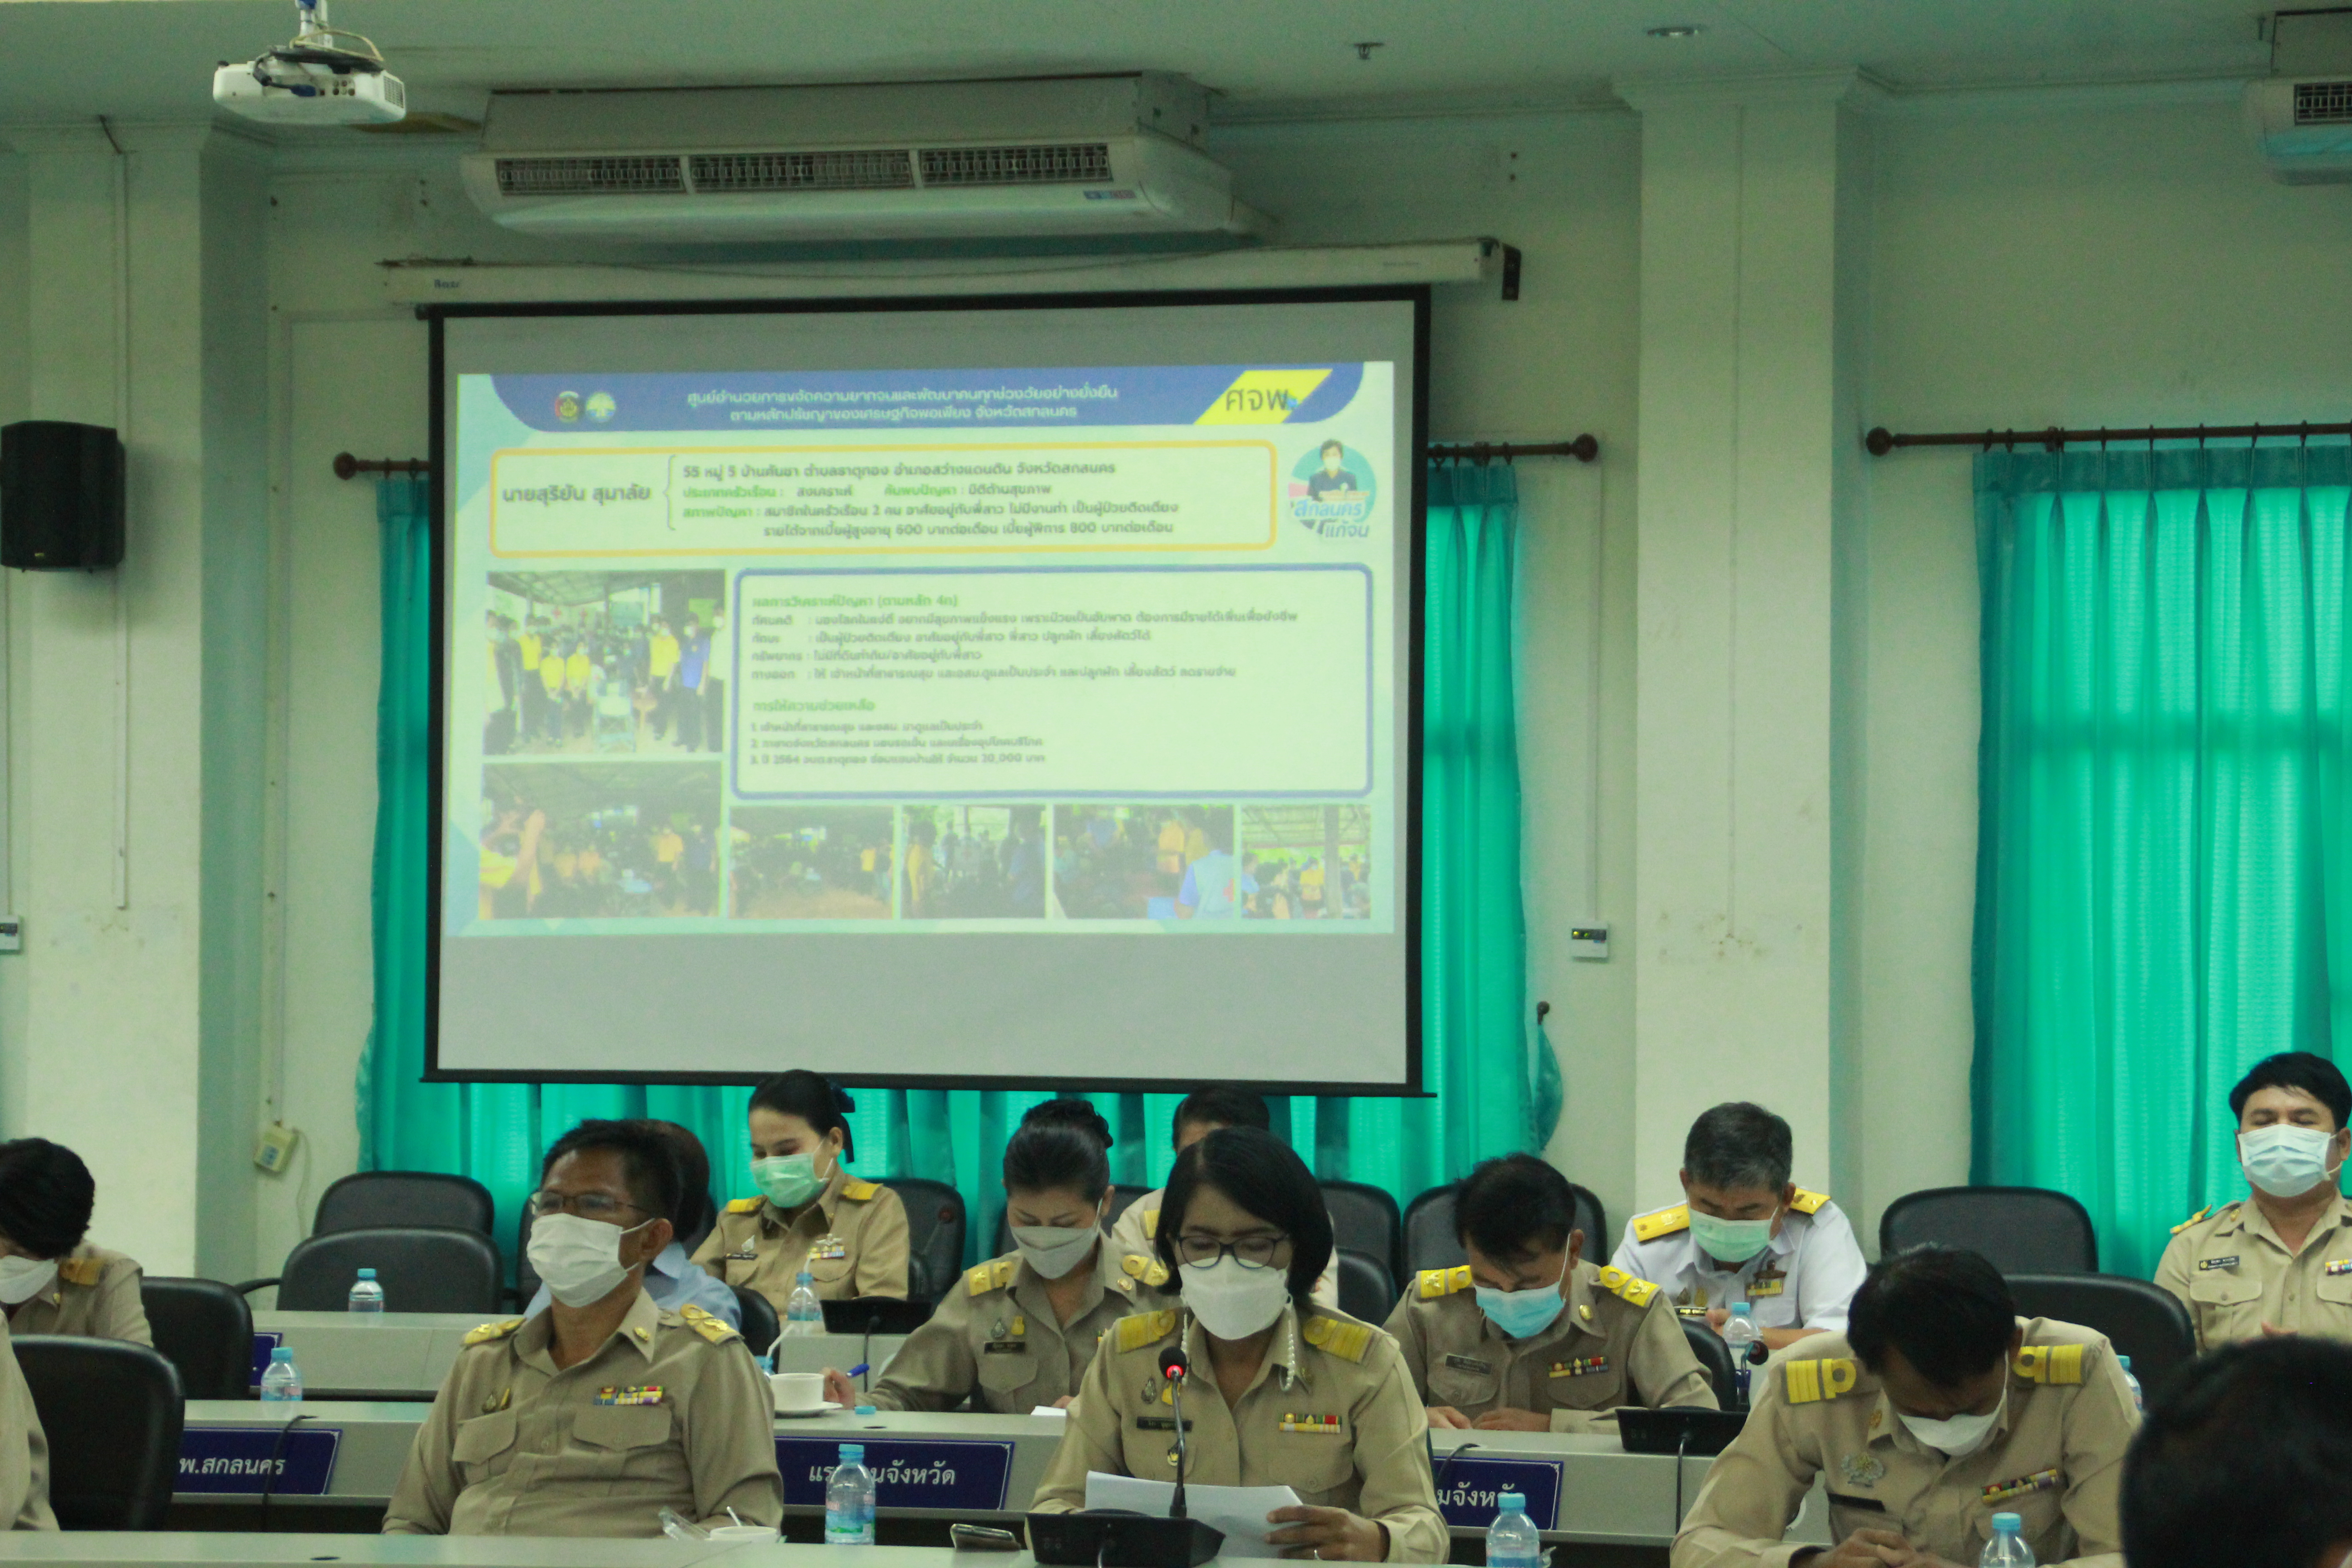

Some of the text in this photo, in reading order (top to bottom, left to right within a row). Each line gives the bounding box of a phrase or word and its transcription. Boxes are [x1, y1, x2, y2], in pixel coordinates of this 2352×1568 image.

[975, 405, 1077, 419] จังหวัดสกลนคร
[684, 465, 699, 479] 55
[706, 464, 722, 482] หมู่
[729, 464, 738, 478] 5
[893, 461, 1011, 477] อำเภอสว่างแดนดิน
[1017, 461, 1116, 475] จังหวัดสกลนคร
[502, 482, 650, 507] นายสุริยัน สุมาลัย
[797, 484, 853, 497] สงเคราะห์
[969, 482, 1051, 497] มิติด้านสุขภาพ
[764, 503, 867, 517] สมาชิกในครัวเรือน
[873, 504, 881, 516] 2
[884, 506, 901, 516] คน
[1009, 500, 1067, 515] ไม่มีงานทำ
[1073, 500, 1178, 518] เป็นผู้ป่วยติดเตียง
[1294, 499, 1362, 516] สกลนคร
[896, 523, 922, 536] 600
[927, 521, 998, 535] บาทต่อเดือน
[1070, 521, 1097, 534] 800
[1101, 519, 1173, 534] บาทต่อเดือน
[809, 1459, 956, 1485] แรนจังหวัด
